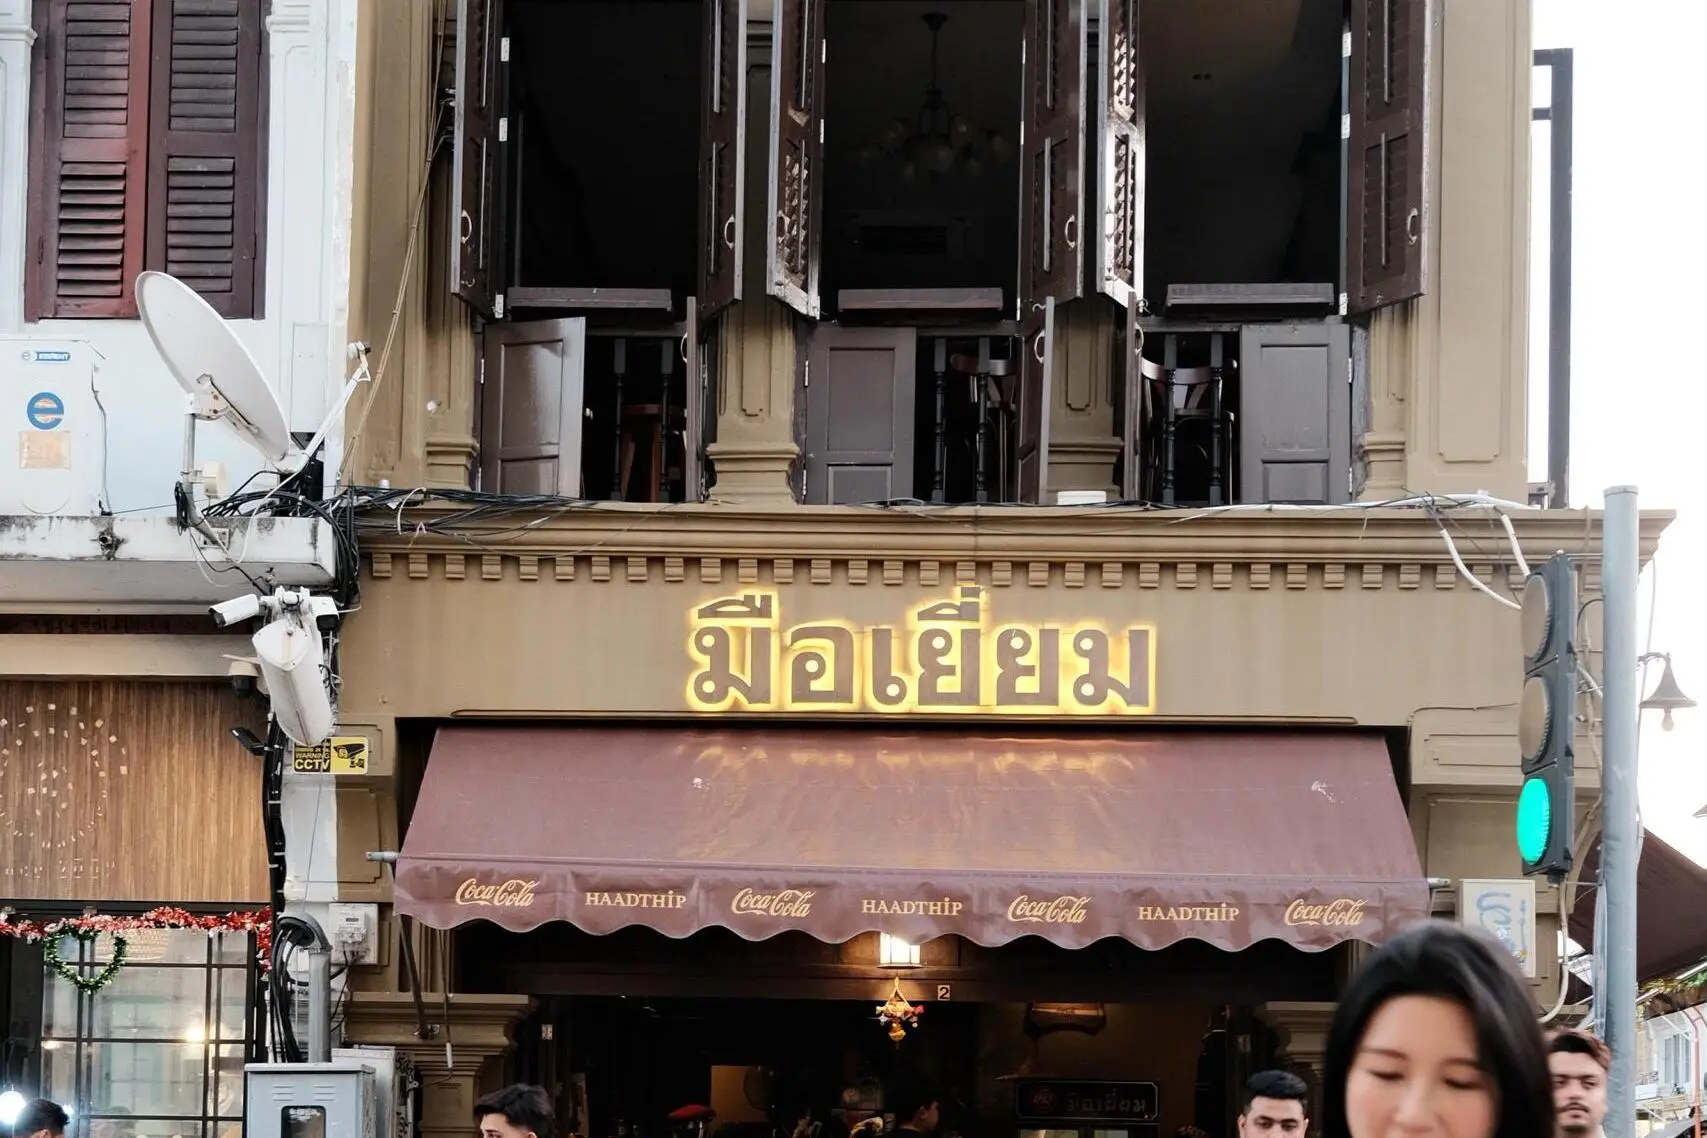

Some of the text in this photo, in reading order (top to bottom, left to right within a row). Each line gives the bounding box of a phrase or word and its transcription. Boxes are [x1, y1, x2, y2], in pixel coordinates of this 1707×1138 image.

[692, 586, 1150, 707] มือเยี่ยม
[295, 760, 330, 770] CCTV
[454, 877, 540, 908] Coca-Cola
[731, 887, 816, 918] Coca-Cola
[1006, 894, 1093, 924] Coca-Cola
[1283, 898, 1370, 927] Coca-Cola
[939, 986, 949, 999] 2
